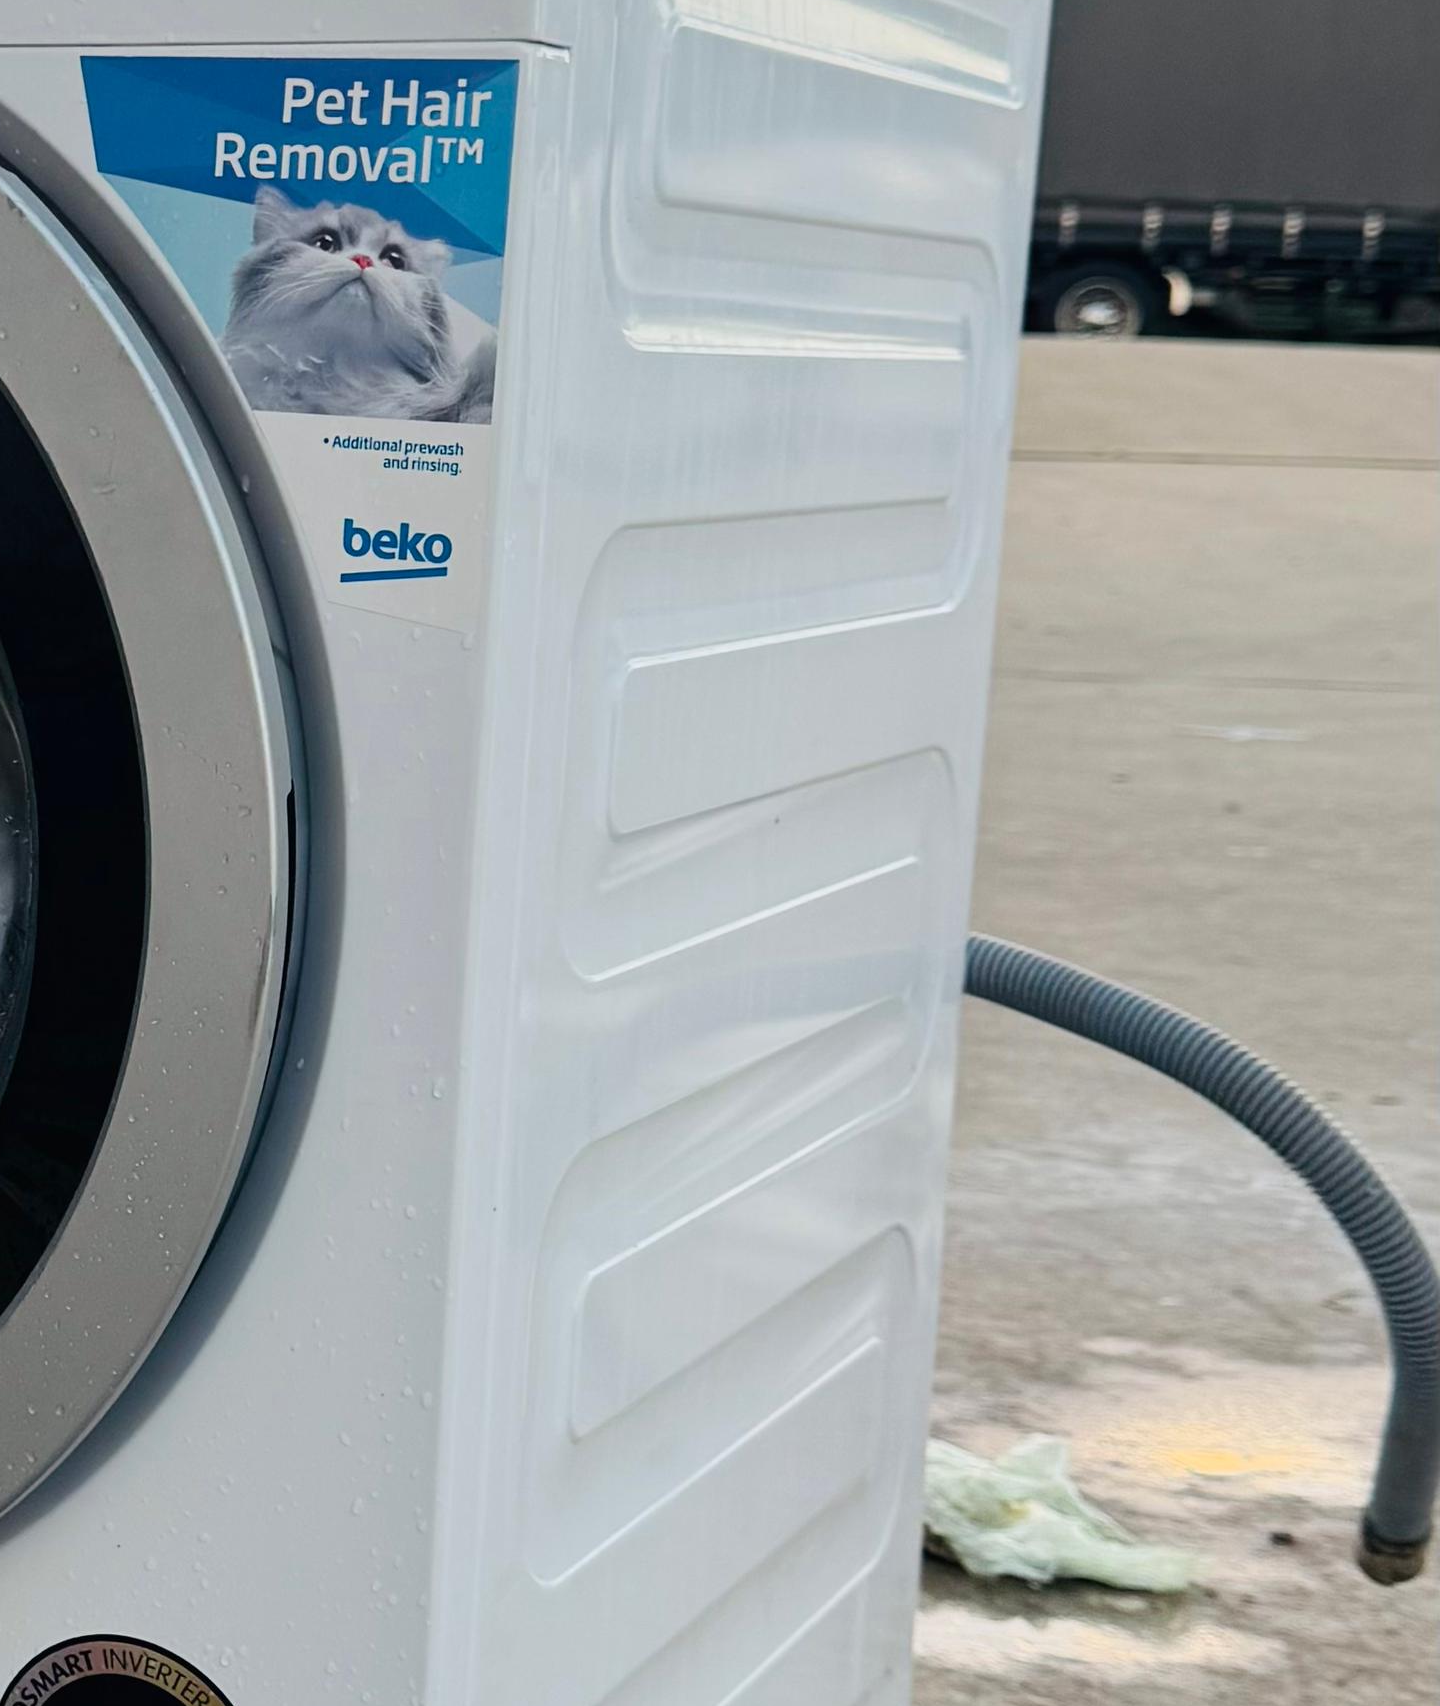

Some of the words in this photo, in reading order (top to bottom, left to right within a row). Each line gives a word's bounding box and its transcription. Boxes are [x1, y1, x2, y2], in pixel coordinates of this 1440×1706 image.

[282, 77, 369, 126] Pet
[380, 77, 492, 128] Hair
[331, 435, 403, 455] Additional
[404, 440, 464, 461] prewash
[382, 455, 409, 471] and
[411, 456, 463, 477] rinsing.
[341, 517, 453, 565] beko
